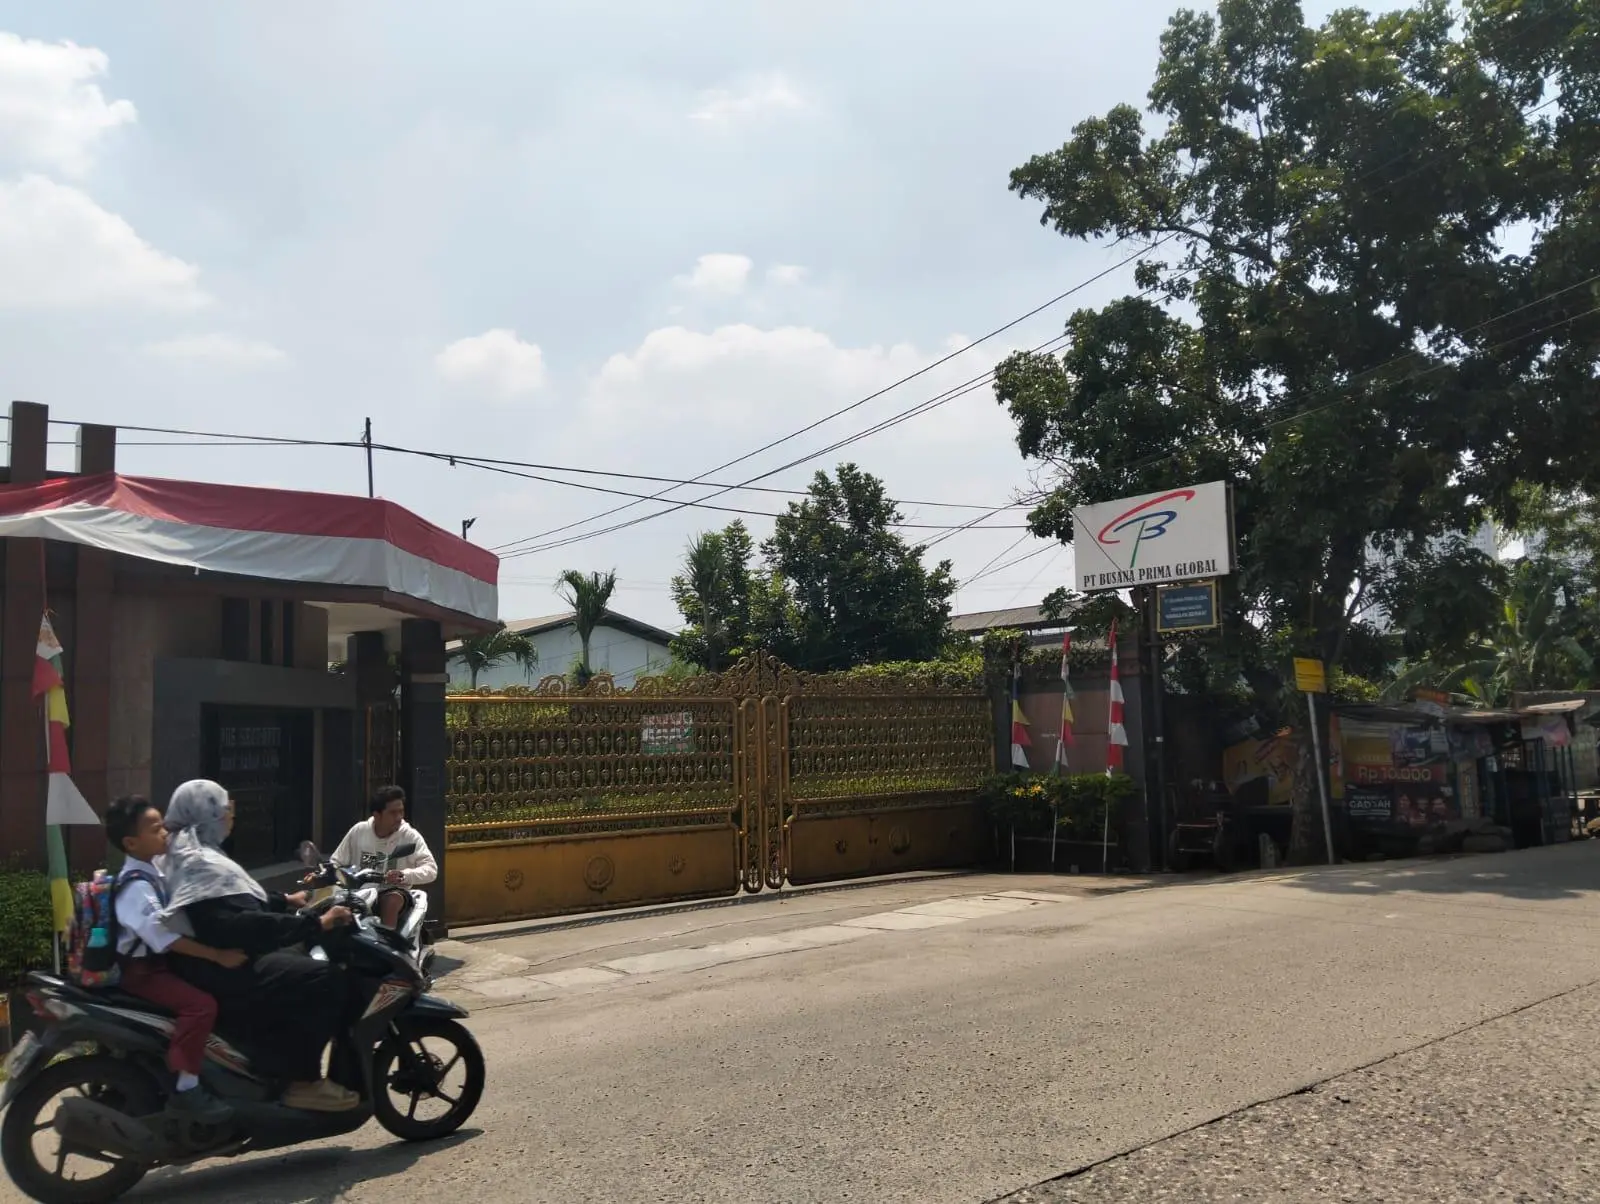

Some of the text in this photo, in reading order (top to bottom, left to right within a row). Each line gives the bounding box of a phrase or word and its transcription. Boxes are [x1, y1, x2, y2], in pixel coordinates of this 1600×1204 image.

[1083, 559, 1218, 588] PT BUSANA PRIMA GLOBAL
[1359, 766, 1432, 784] Rp 10.000
